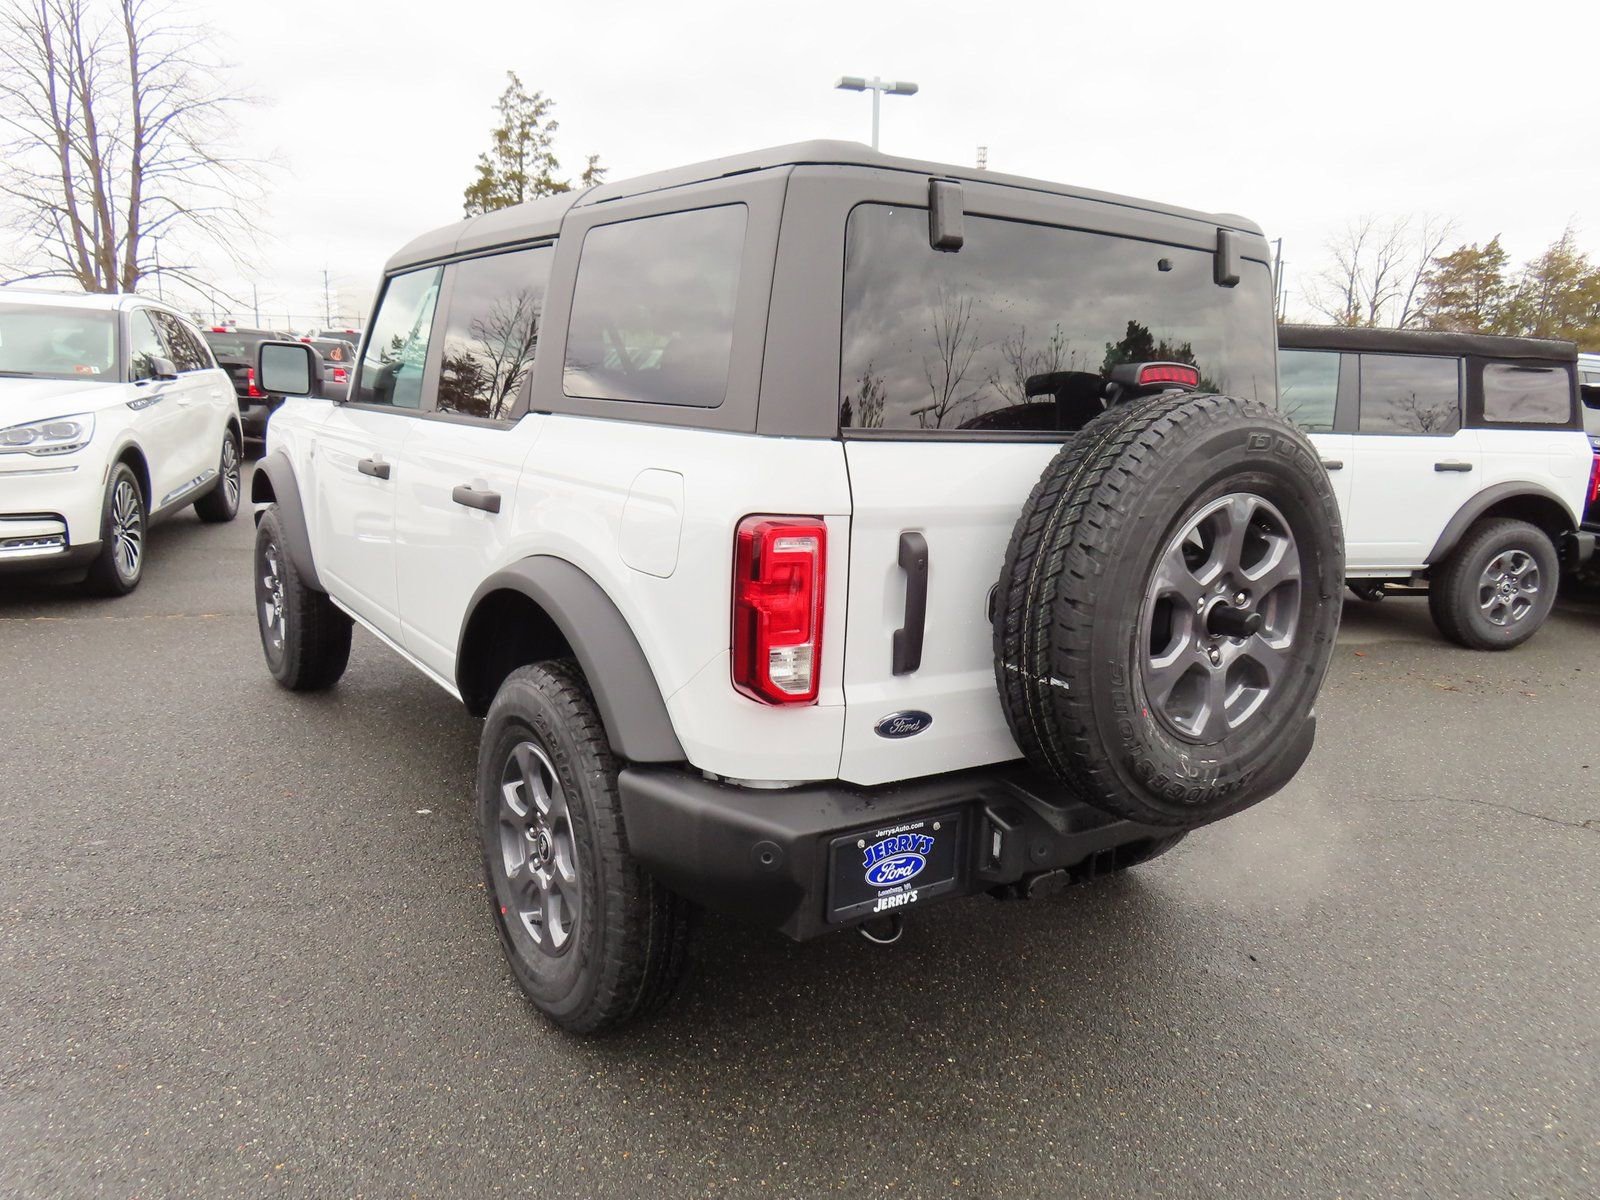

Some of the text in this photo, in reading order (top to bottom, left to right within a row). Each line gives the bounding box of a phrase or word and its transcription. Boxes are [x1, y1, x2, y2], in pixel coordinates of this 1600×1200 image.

[889, 716, 920, 733] Ford
[875, 821, 924, 837] JerrysAuto.com
[862, 833, 935, 868] JERRY'S
[876, 858, 915, 883] Ford
[873, 889, 918, 913] JERRY'S
